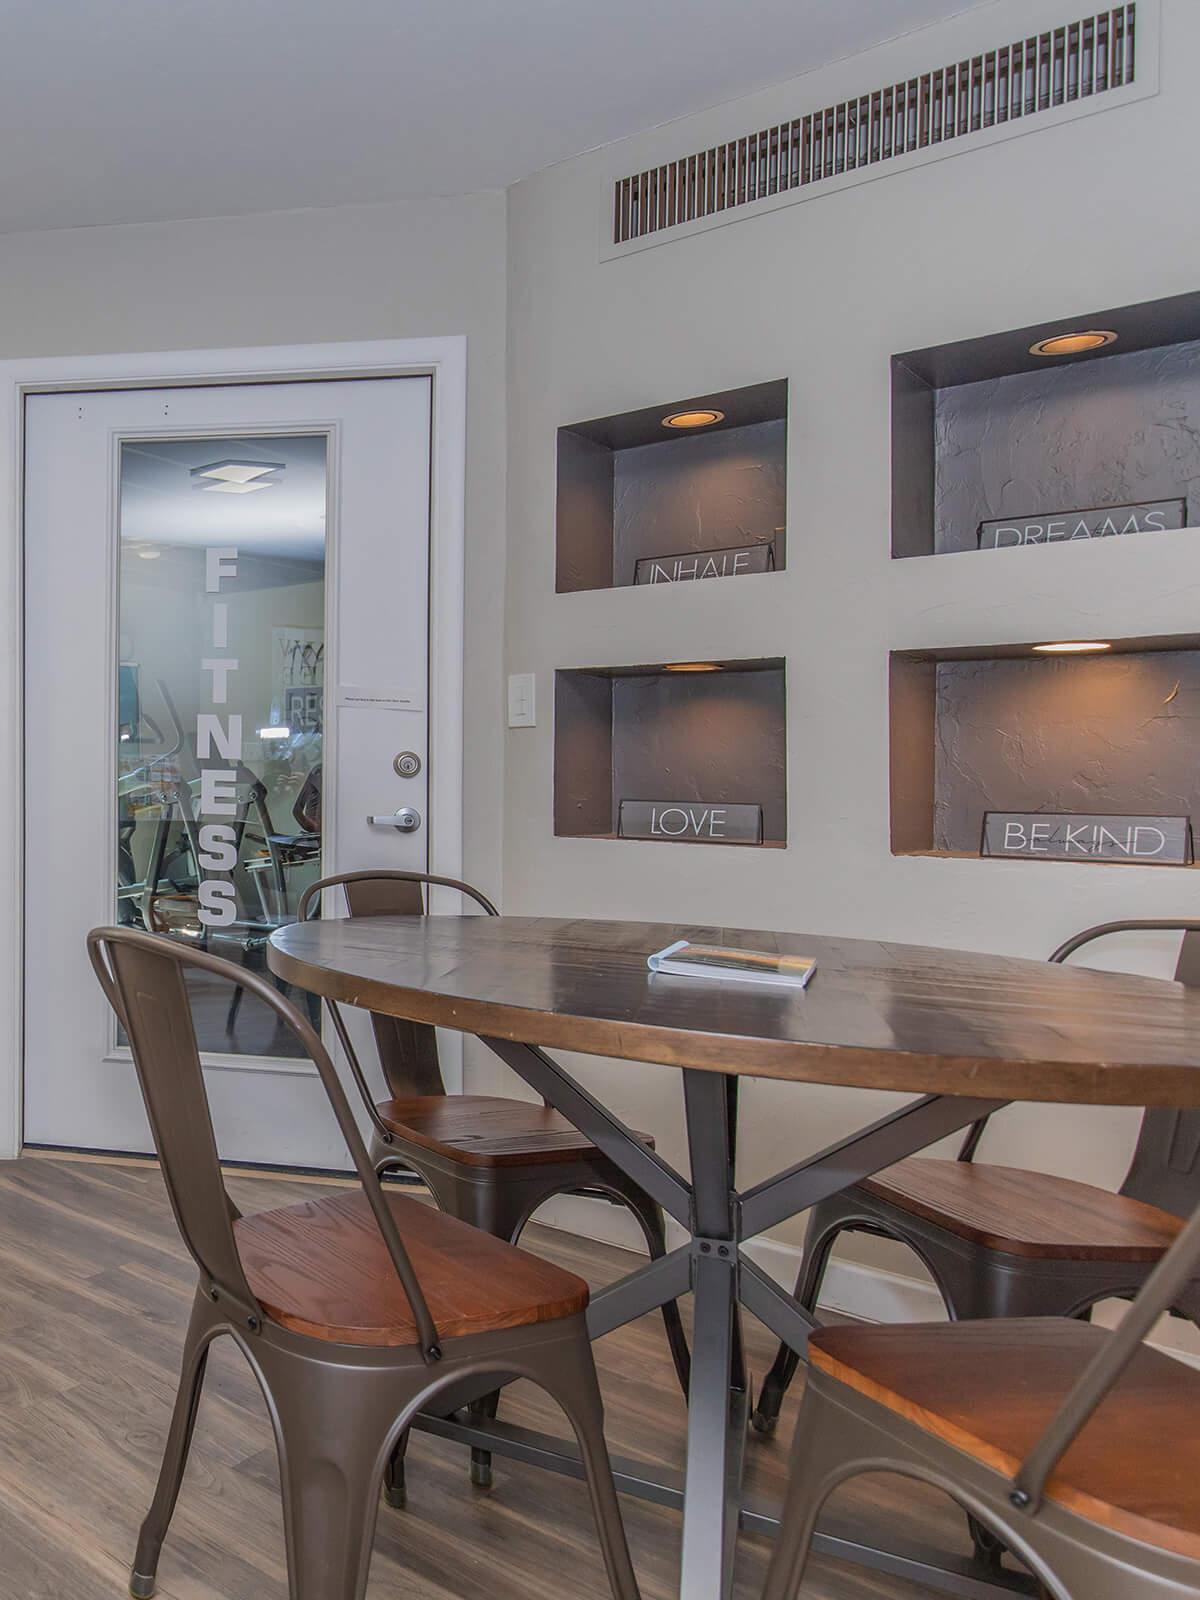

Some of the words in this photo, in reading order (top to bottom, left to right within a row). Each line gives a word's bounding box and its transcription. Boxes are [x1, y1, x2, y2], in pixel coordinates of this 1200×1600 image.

[994, 511, 1166, 548] DREAMS
[196, 547, 242, 927] FITNESS
[651, 807, 727, 837] LOVE
[1004, 822, 1050, 851] BE
[1065, 824, 1165, 855] KIND
